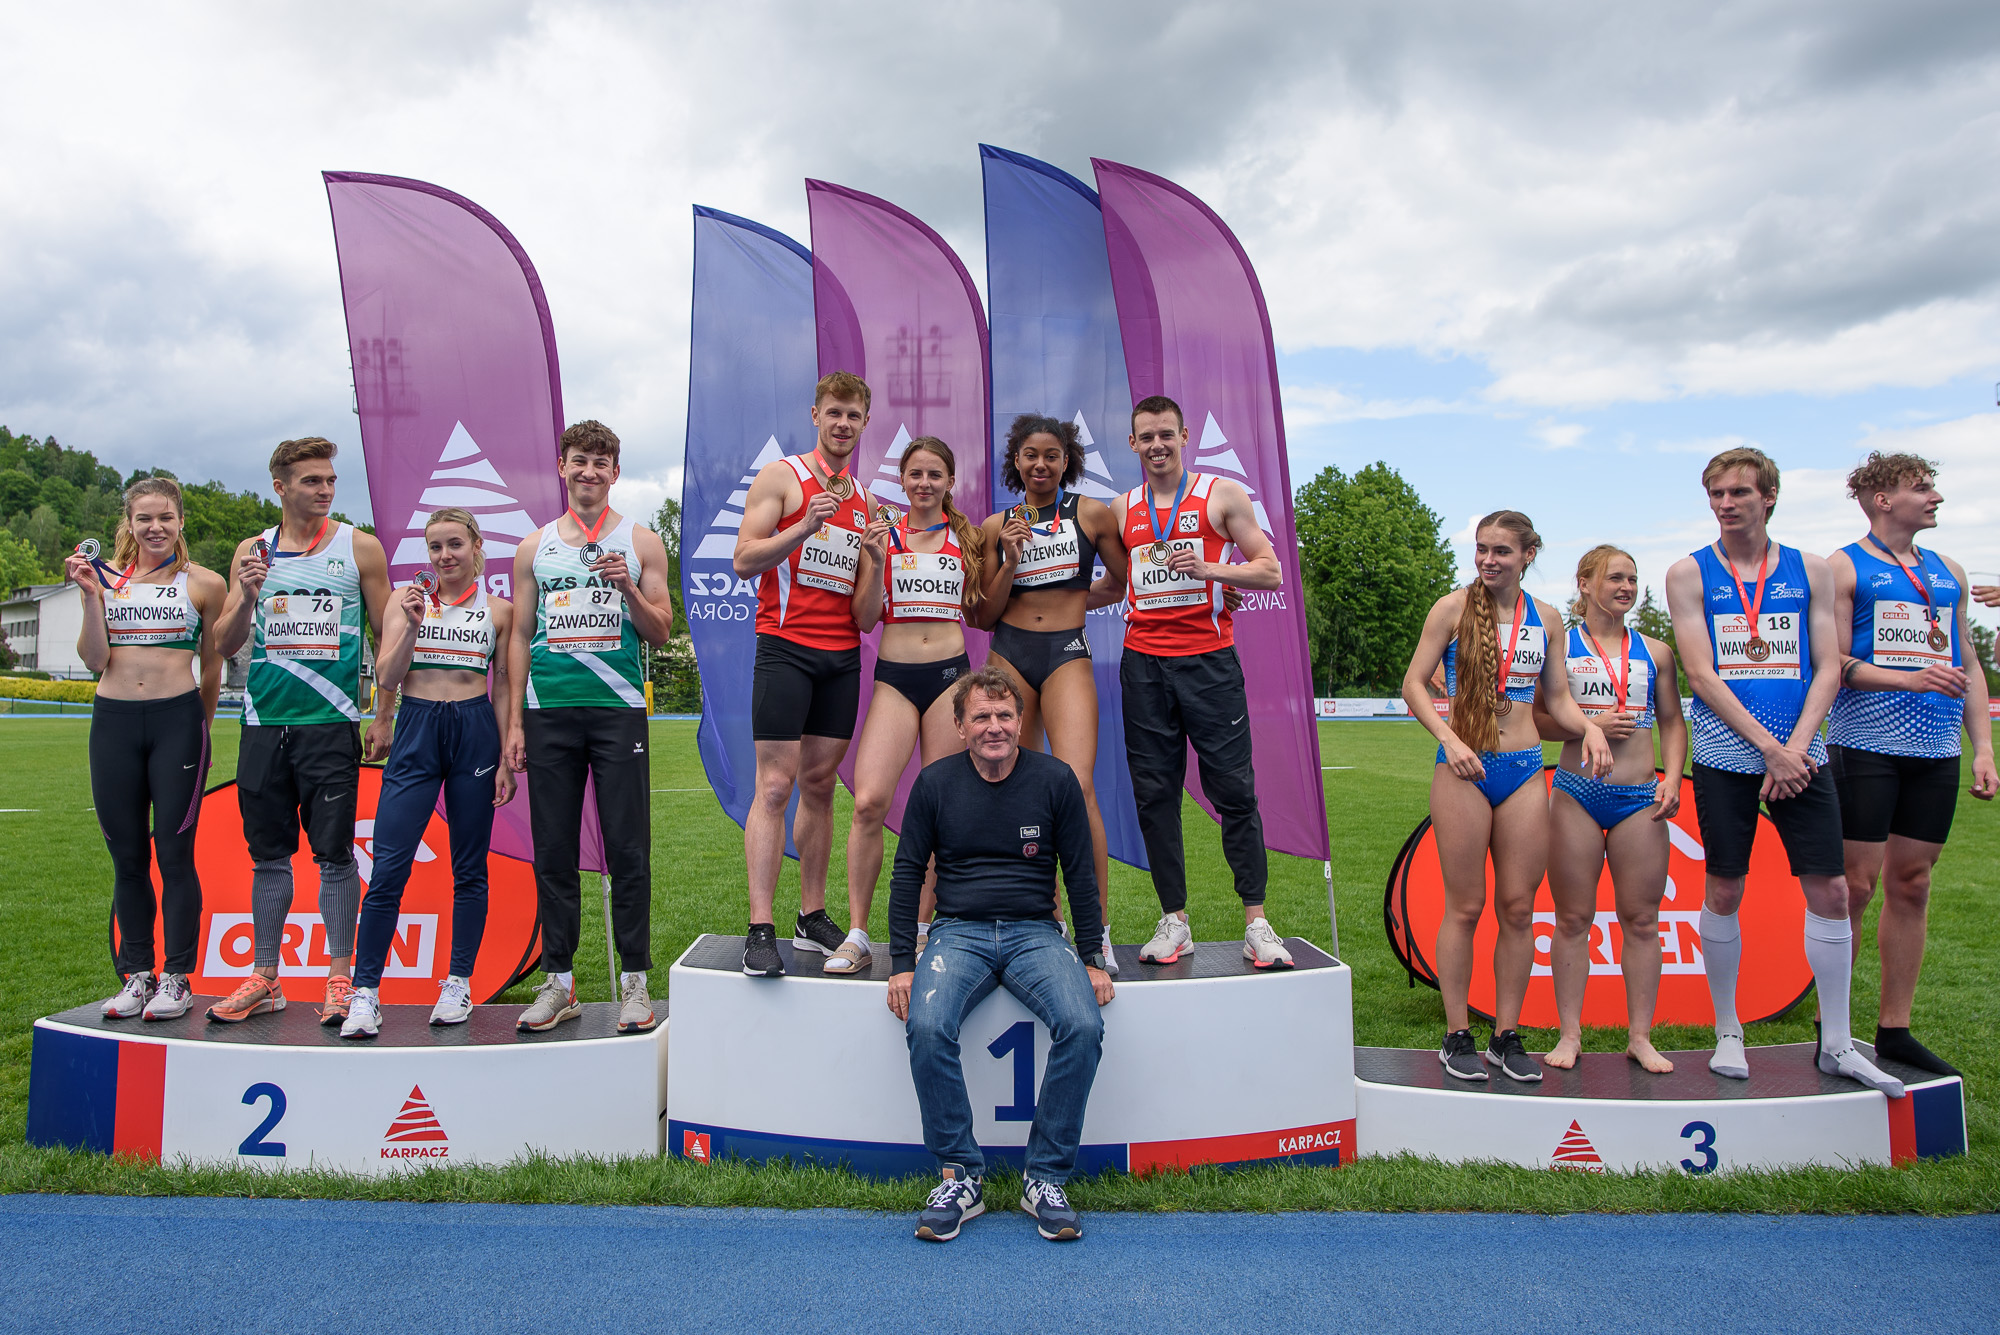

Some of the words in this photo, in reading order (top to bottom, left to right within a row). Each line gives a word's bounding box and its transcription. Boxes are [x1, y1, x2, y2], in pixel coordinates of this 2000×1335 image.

[846, 533, 860, 550] 92
[1018, 540, 1077, 565] ZYŻEWSKA
[938, 556, 957, 571] 93
[806, 576, 837, 588] KARPACZ
[1018, 574, 1048, 584] KARPACZ
[1049, 570, 1065, 578] 2022
[155, 587, 178, 598] 78
[896, 578, 960, 596] WSOŁEK
[591, 590, 613, 605] 87
[1143, 597, 1172, 605] KARPACZ
[107, 606, 184, 621] BARTNOWSKA
[311, 599, 334, 613] 76
[465, 610, 486, 623] 79
[548, 613, 620, 630] ZAWADZKI
[1768, 616, 1791, 630] 18
[267, 622, 338, 637] ADAMCZEWSKI
[417, 625, 489, 646] BIELIŃSKA
[423, 653, 456, 661] KARPACZ
[220, 922, 422, 968] ORLN
[986, 1021, 1038, 1122] 1
[238, 1081, 287, 1157] 2
[1279, 1130, 1342, 1153] KARPACZ
[1679, 1120, 1719, 1176] 3
[380, 1146, 449, 1159] KARPACZ
